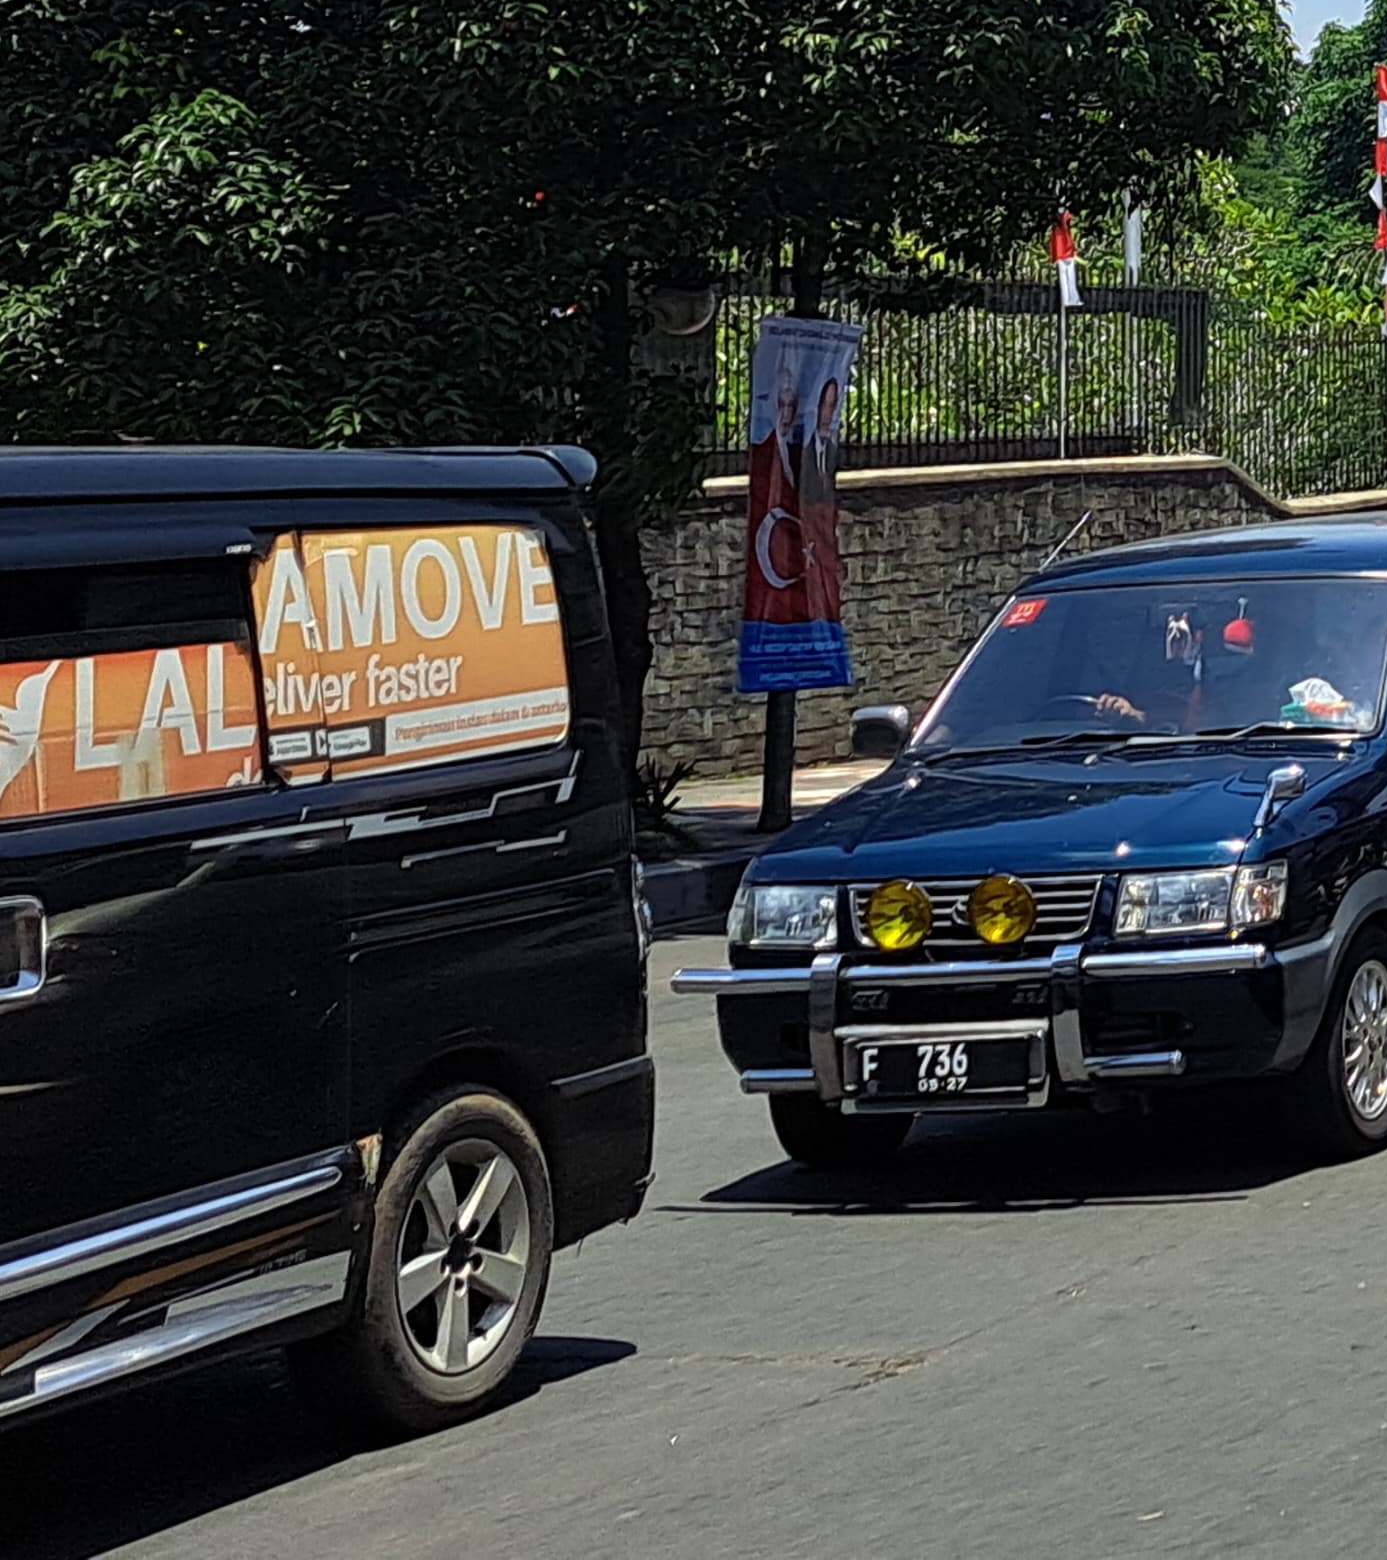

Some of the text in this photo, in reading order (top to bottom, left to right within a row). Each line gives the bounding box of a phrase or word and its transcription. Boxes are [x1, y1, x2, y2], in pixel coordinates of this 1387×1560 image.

[367, 653, 463, 707] faster
[862, 1043, 968, 1081] F 736
